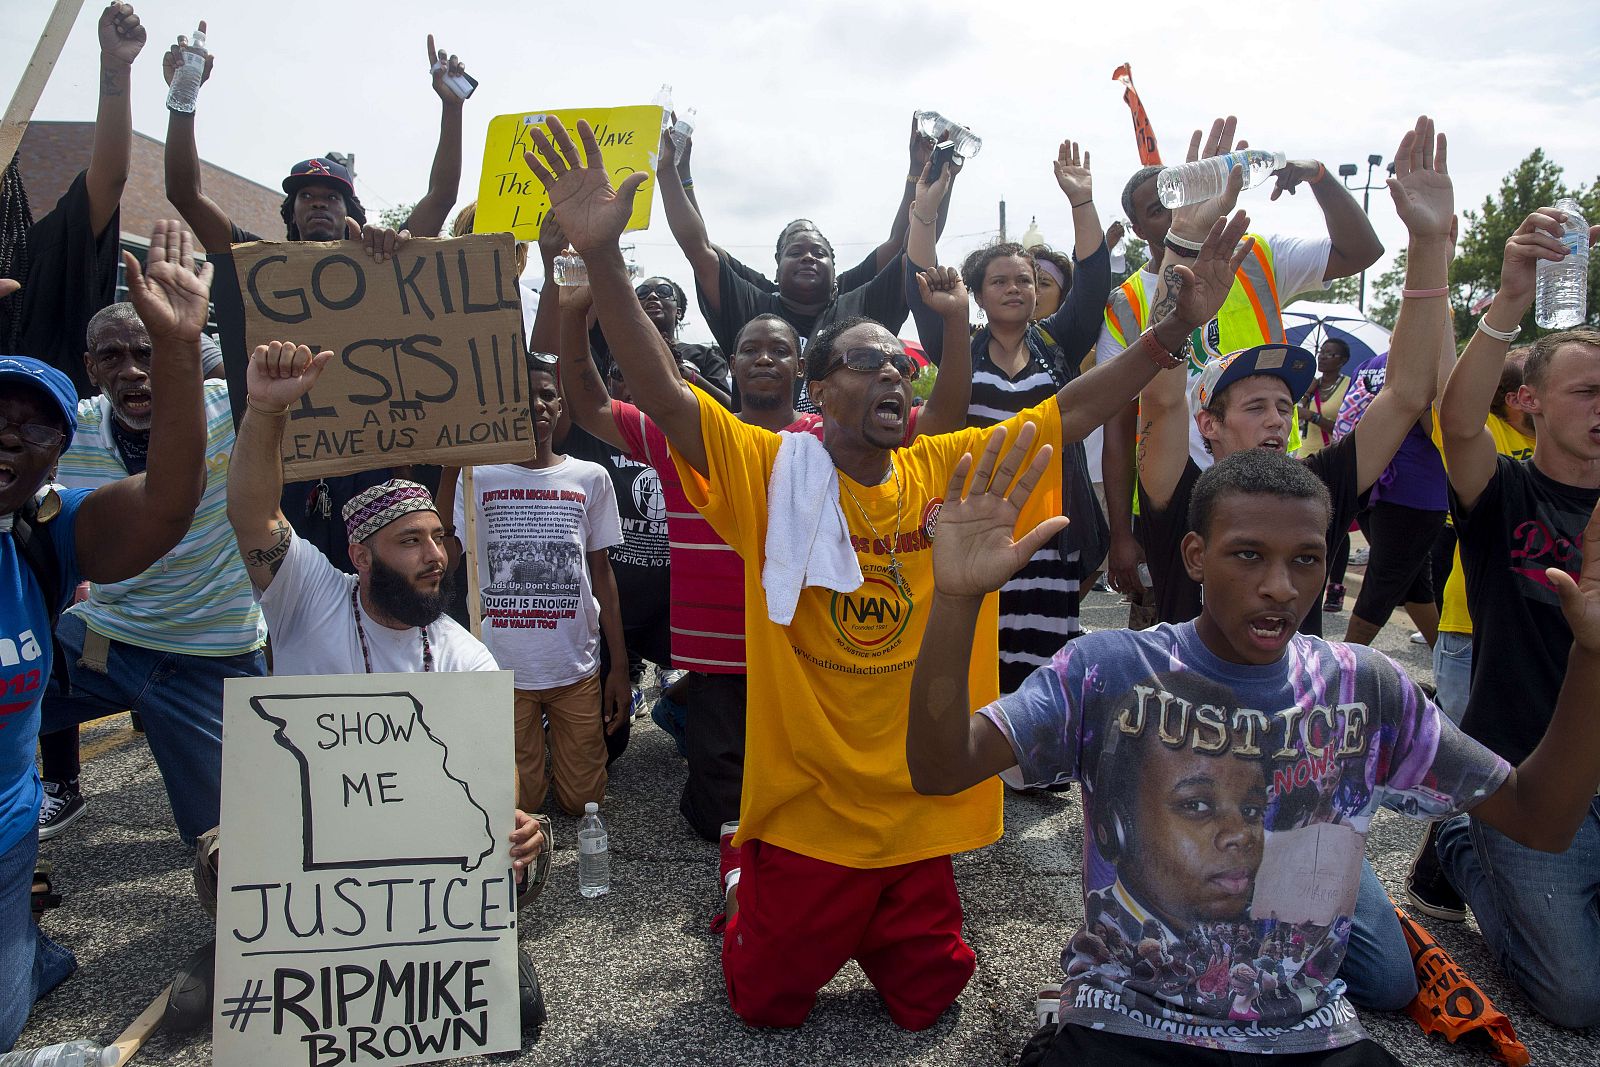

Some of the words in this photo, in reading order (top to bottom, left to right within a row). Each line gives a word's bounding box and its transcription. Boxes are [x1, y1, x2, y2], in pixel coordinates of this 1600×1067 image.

[495, 171, 532, 196] The
[246, 253, 367, 325] GO
[392, 248, 522, 321] KILL
[362, 407, 427, 429] AND
[377, 426, 419, 453] US
[435, 417, 531, 447] ALONE
[510, 489, 525, 500] FOR
[526, 489, 559, 500] MICHAEL
[620, 516, 648, 533] N'T
[648, 521, 669, 535] SH
[610, 552, 649, 567] JUSTICE,
[650, 558, 663, 567] NO
[509, 581, 523, 590] Up,
[525, 582, 550, 590] Don't
[485, 597, 517, 609] OUGH
[519, 598, 530, 609] IS
[532, 598, 579, 610] ENOUGH!
[842, 595, 901, 624] NAN
[509, 619, 536, 629] VALUE
[836, 637, 845, 647] NO
[843, 646, 869, 658] JUSTICE
[882, 639, 903, 655] PEACE
[316, 711, 416, 749] SHOW
[1118, 684, 1369, 760] JUSTICE
[1273, 742, 1336, 796] NOW!
[342, 771, 404, 807] ME
[231, 867, 516, 943] JUSTICE!
[220, 958, 491, 1035] #RIPMIKE
[300, 1010, 488, 1067] BROWN
